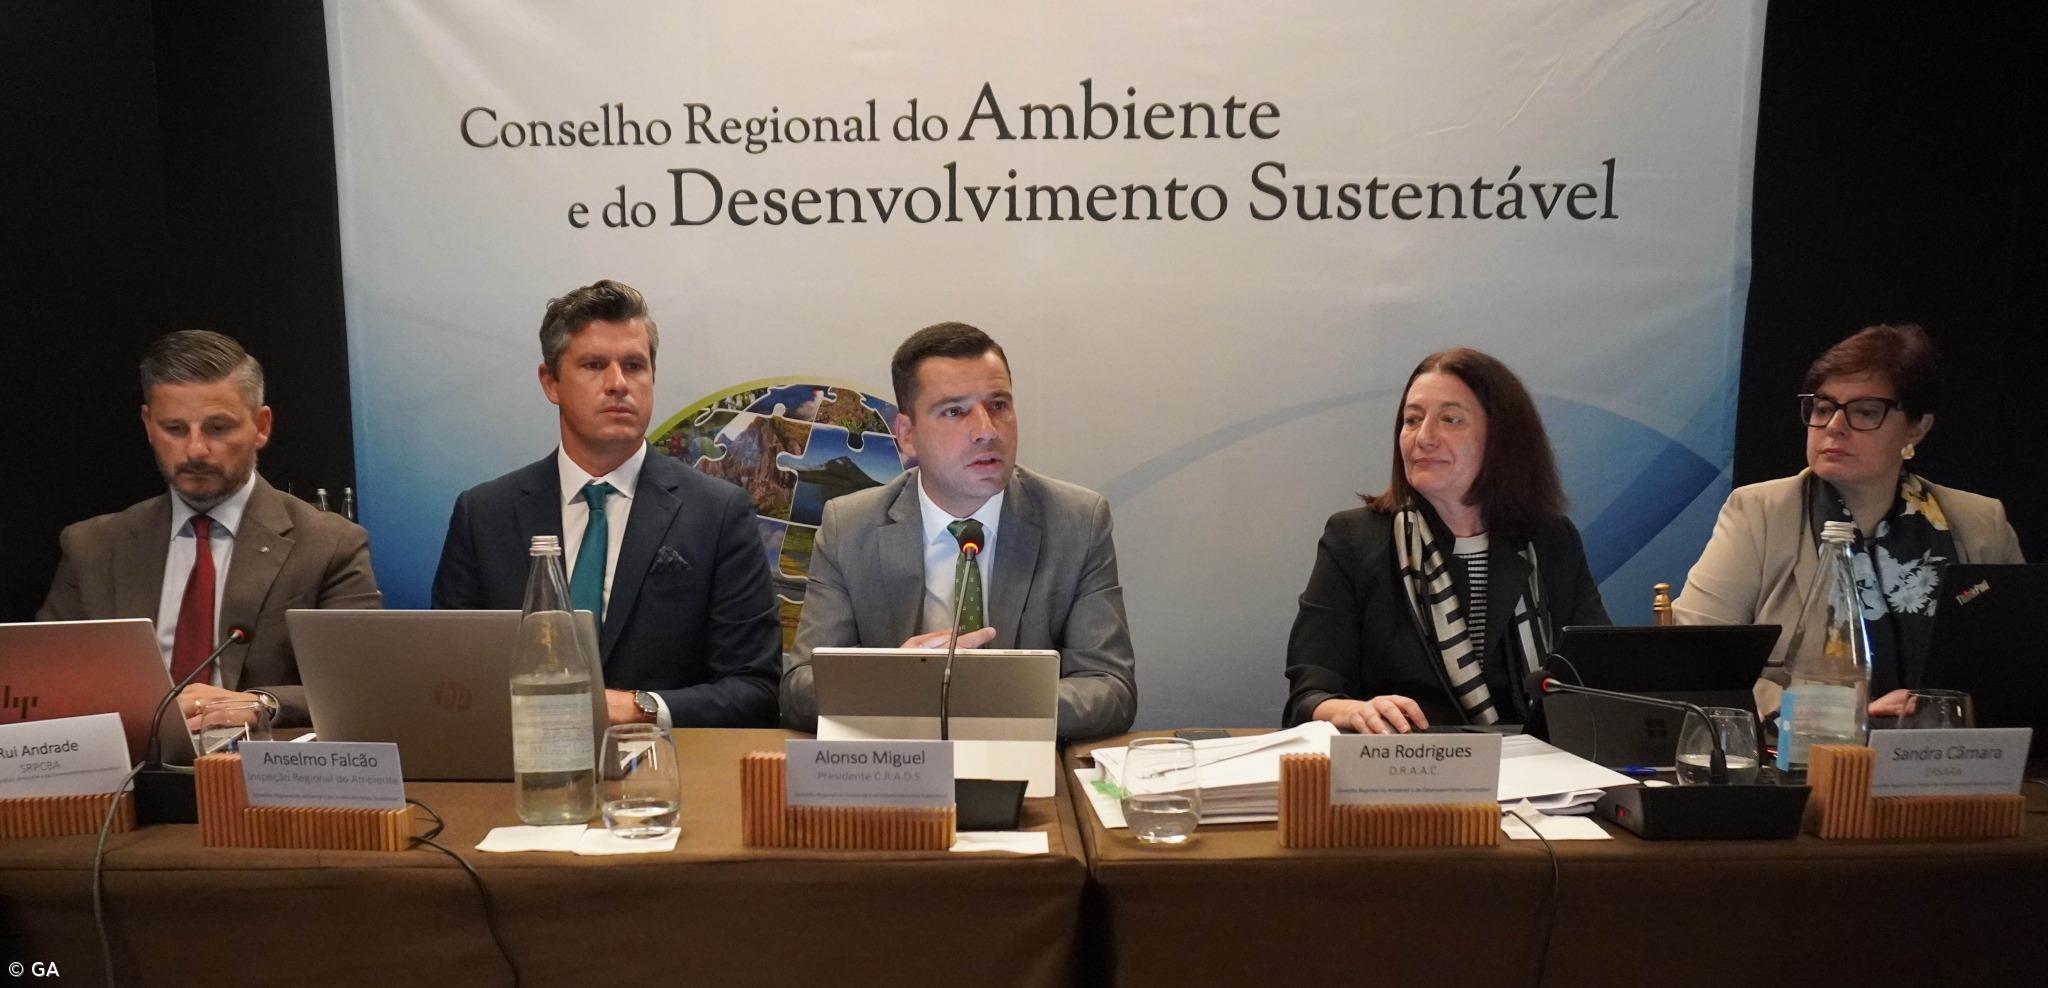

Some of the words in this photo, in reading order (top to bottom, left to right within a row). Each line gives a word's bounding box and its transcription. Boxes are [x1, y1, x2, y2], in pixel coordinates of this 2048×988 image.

[460, 102, 672, 149] Conselho
[683, 102, 880, 155] Regional
[892, 97, 949, 143] do
[957, 77, 1281, 142] Ambiente
[567, 202, 590, 229] e
[601, 185, 657, 229] do
[666, 161, 1229, 227] Desenvolvimento
[1248, 157, 1619, 222] Sustentável
[0, 746, 18, 760] Rui
[21, 741, 79, 757] Andrade
[815, 750, 868, 765] Alonso
[872, 750, 926, 768] Miguel
[1359, 745, 1390, 759] Ana
[1395, 744, 1472, 761] Rodrigues
[1892, 746, 1944, 761] Sandra
[1947, 745, 2003, 760] Câmara
[263, 752, 327, 767] Anselmo
[331, 752, 378, 768] Falcão
[293, 774, 334, 785] Regional
[817, 771, 871, 782] Presidente
